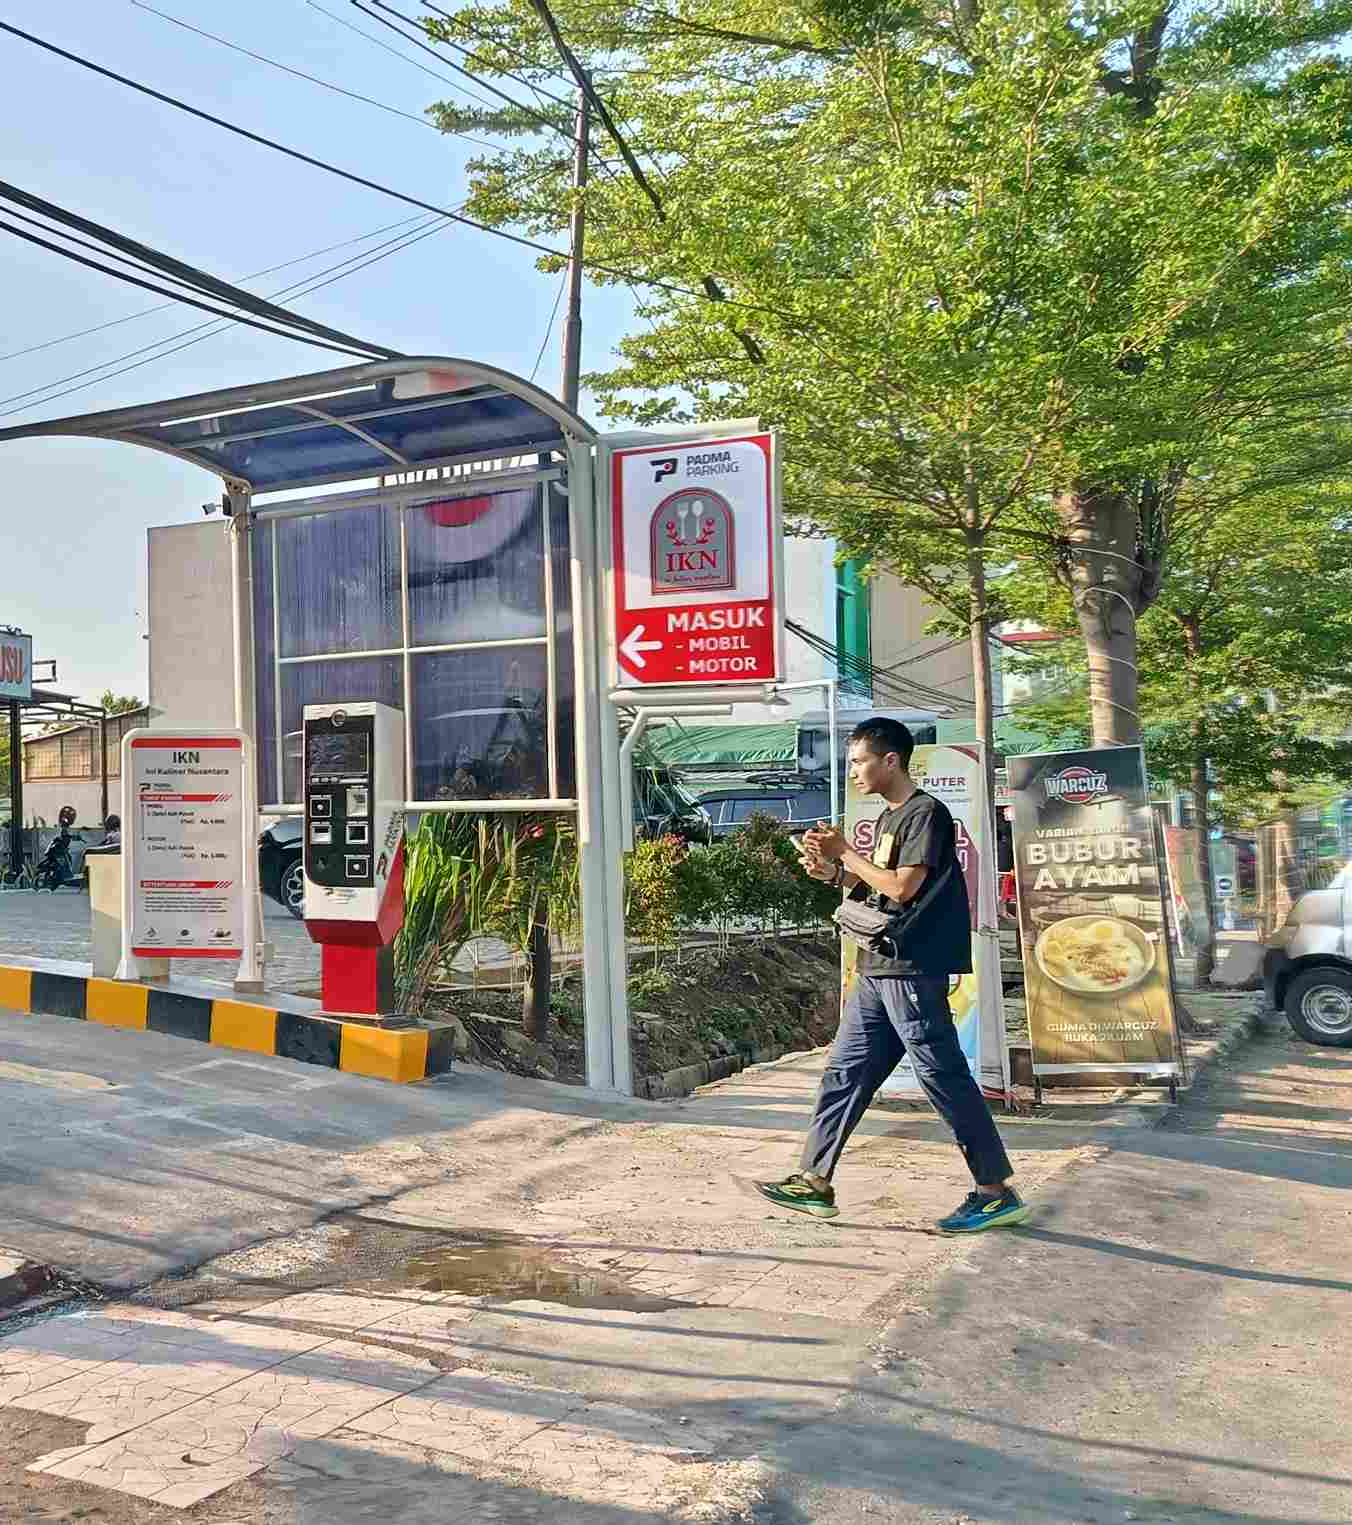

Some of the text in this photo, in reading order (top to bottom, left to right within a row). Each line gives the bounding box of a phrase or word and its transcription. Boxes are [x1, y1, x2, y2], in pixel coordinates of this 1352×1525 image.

[686, 451, 732, 465] PADMA
[686, 462, 740, 477] PARKING
[665, 549, 720, 574] IKN
[667, 607, 765, 633] MASUK
[689, 635, 750, 652] MOBIL
[689, 656, 758, 674] MOTOR
[172, 751, 200, 764] IKN
[187, 767, 230, 775] Nusantara
[923, 776, 967, 787] PUTER
[1045, 773, 1108, 795] WARCUZ
[1026, 837, 1144, 865] BUBUR
[1033, 863, 1141, 890] AYAM
